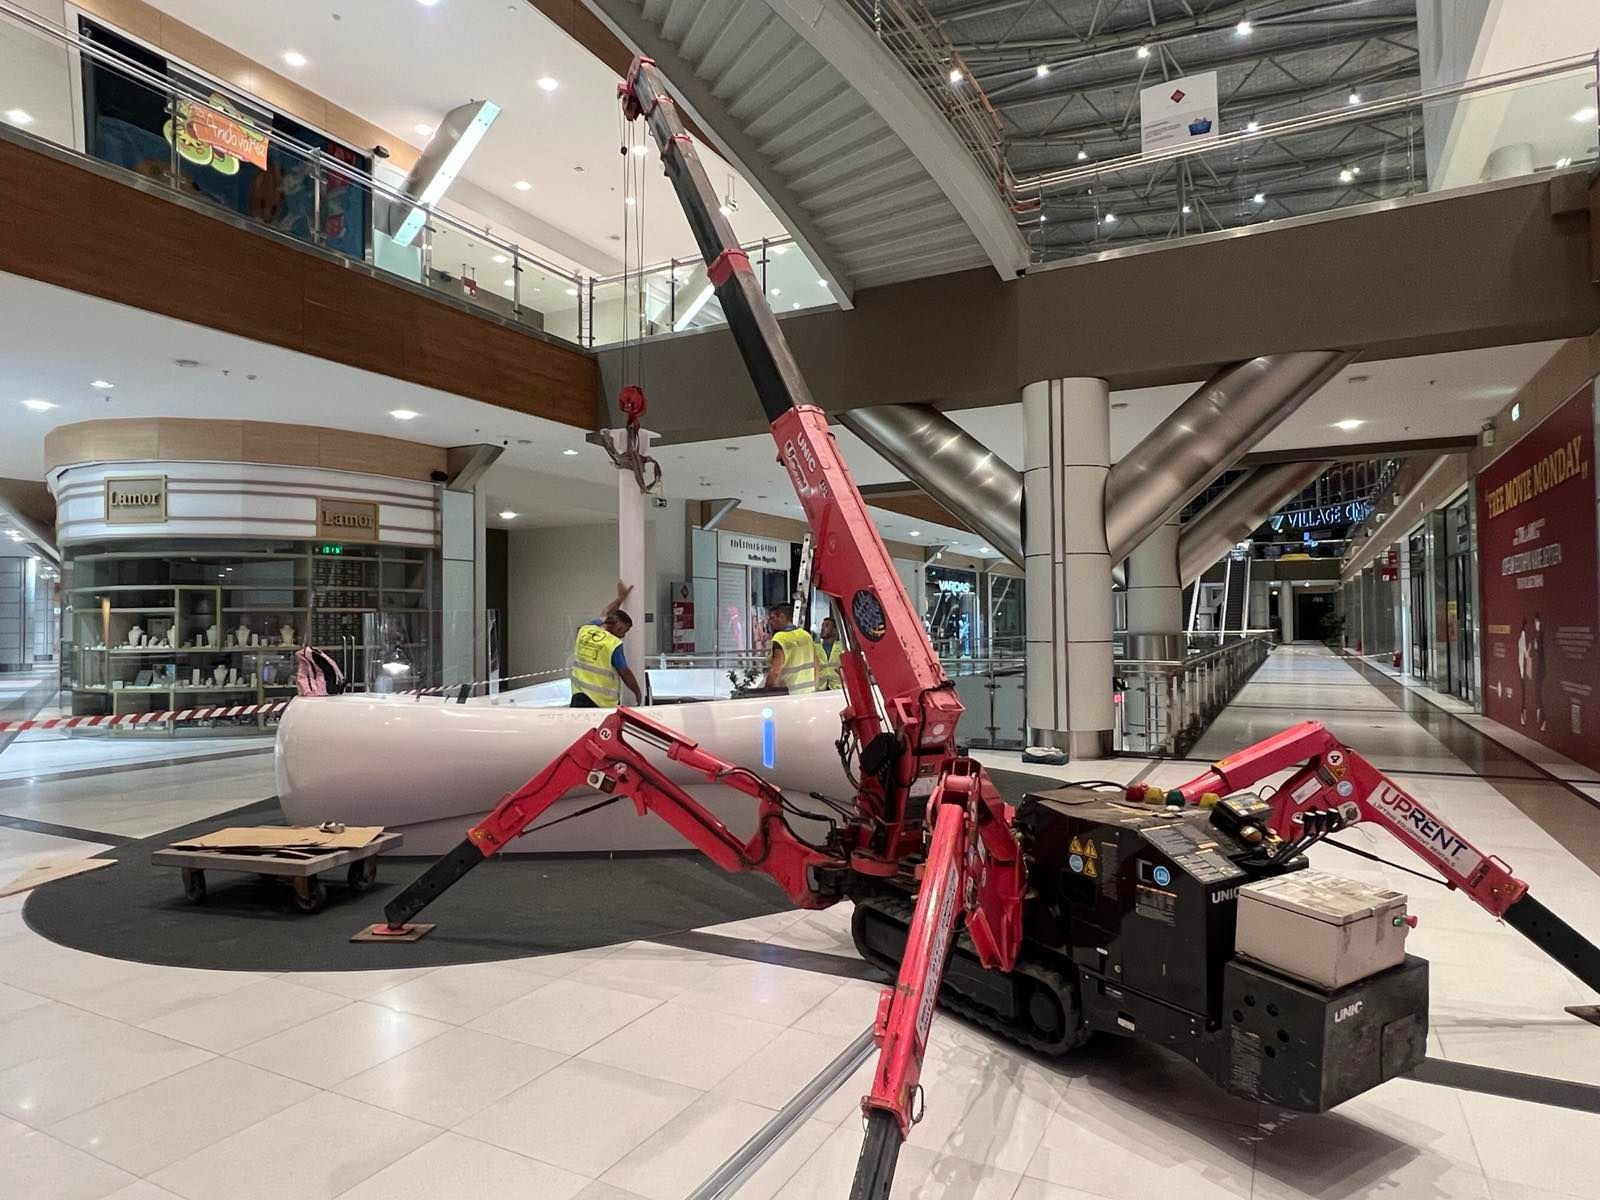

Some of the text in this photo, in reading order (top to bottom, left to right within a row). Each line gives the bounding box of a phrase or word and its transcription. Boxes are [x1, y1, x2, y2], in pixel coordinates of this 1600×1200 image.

[797, 432, 816, 473] UNIC
[111, 491, 161, 507] Lamor
[1505, 468, 1532, 511] MOVIE
[321, 511, 373, 529] Lamor
[1287, 506, 1341, 528] VILLAGE
[1330, 754, 1341, 764] 4
[1381, 786, 1468, 857] UPRENT
[1211, 886, 1240, 904] UNIC
[1334, 1000, 1364, 1023] UNIC
